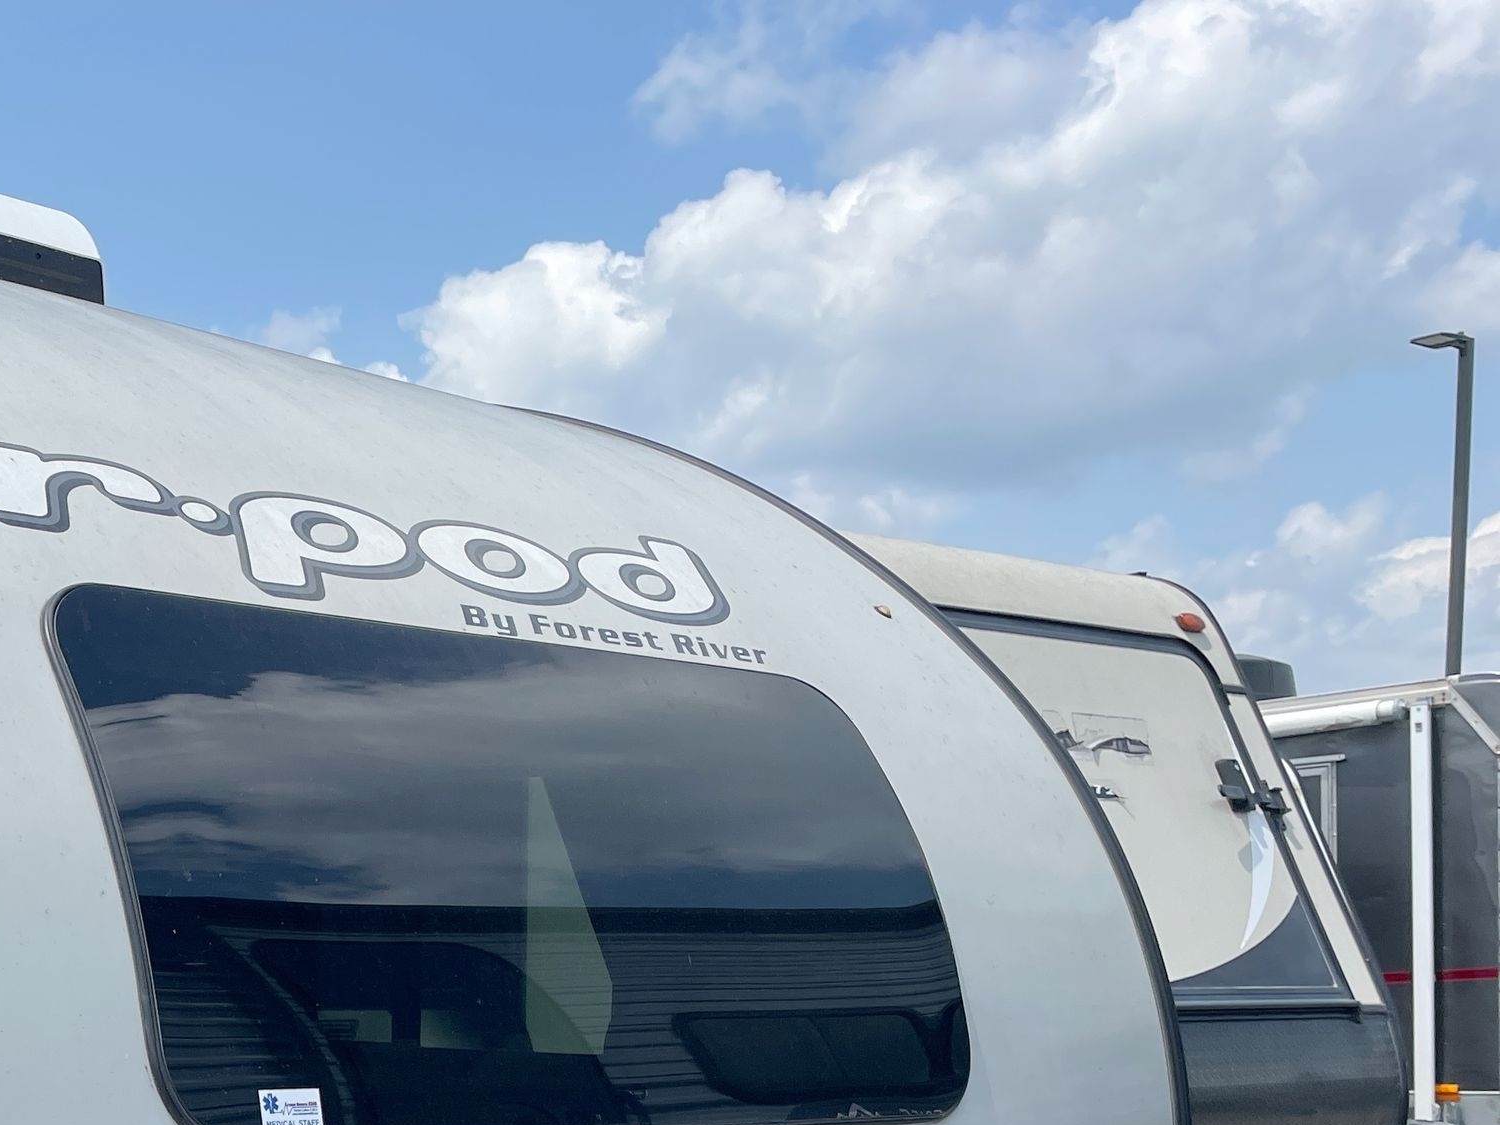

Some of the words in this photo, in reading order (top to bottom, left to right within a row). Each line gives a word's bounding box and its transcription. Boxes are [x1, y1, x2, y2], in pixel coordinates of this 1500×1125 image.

[460, 603, 518, 637] By
[529, 614, 664, 651] Forest
[670, 633, 767, 665] River
